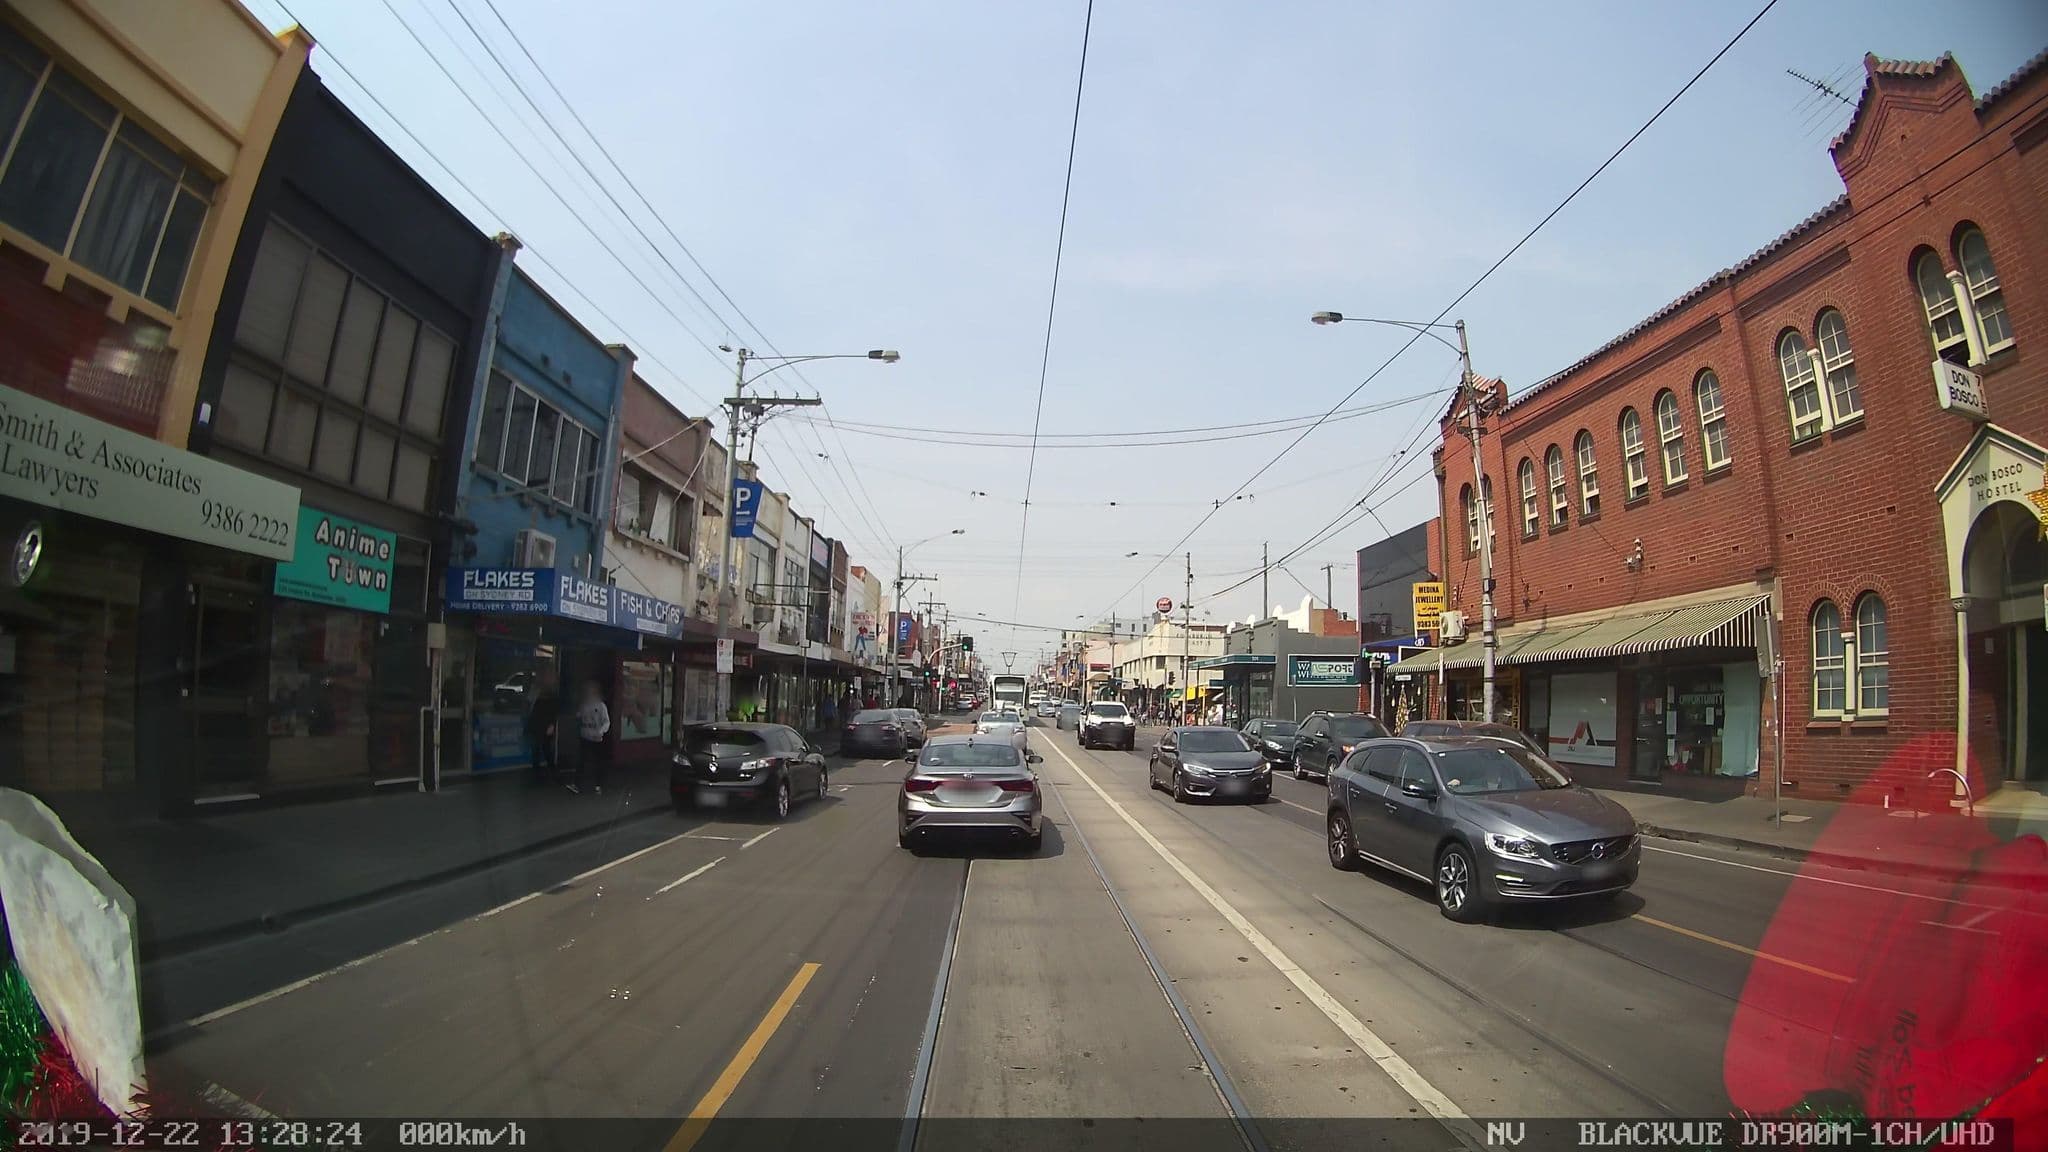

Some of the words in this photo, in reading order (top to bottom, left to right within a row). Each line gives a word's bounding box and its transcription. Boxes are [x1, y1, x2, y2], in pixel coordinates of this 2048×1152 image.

[1951, 369, 1971, 388] DON
[1950, 386, 1979, 407] BOSCO
[1, 443, 99, 499] Lawyers
[64, 429, 85, 460] &
[91, 438, 202, 496] Associates
[1967, 472, 1989, 488] DON
[1992, 462, 2023, 482] BOSCO
[736, 487, 751, 509] P
[1977, 481, 2022, 501] HOSTEL
[201, 499, 244, 536] 9386
[248, 513, 289, 547] 2222
[315, 516, 390, 561] Anime
[463, 569, 535, 589] FLAKES
[560, 575, 608, 607] FLAKES
[621, 591, 643, 616] FISH
[645, 599, 653, 618] &
[655, 601, 681, 625] CHIPS
